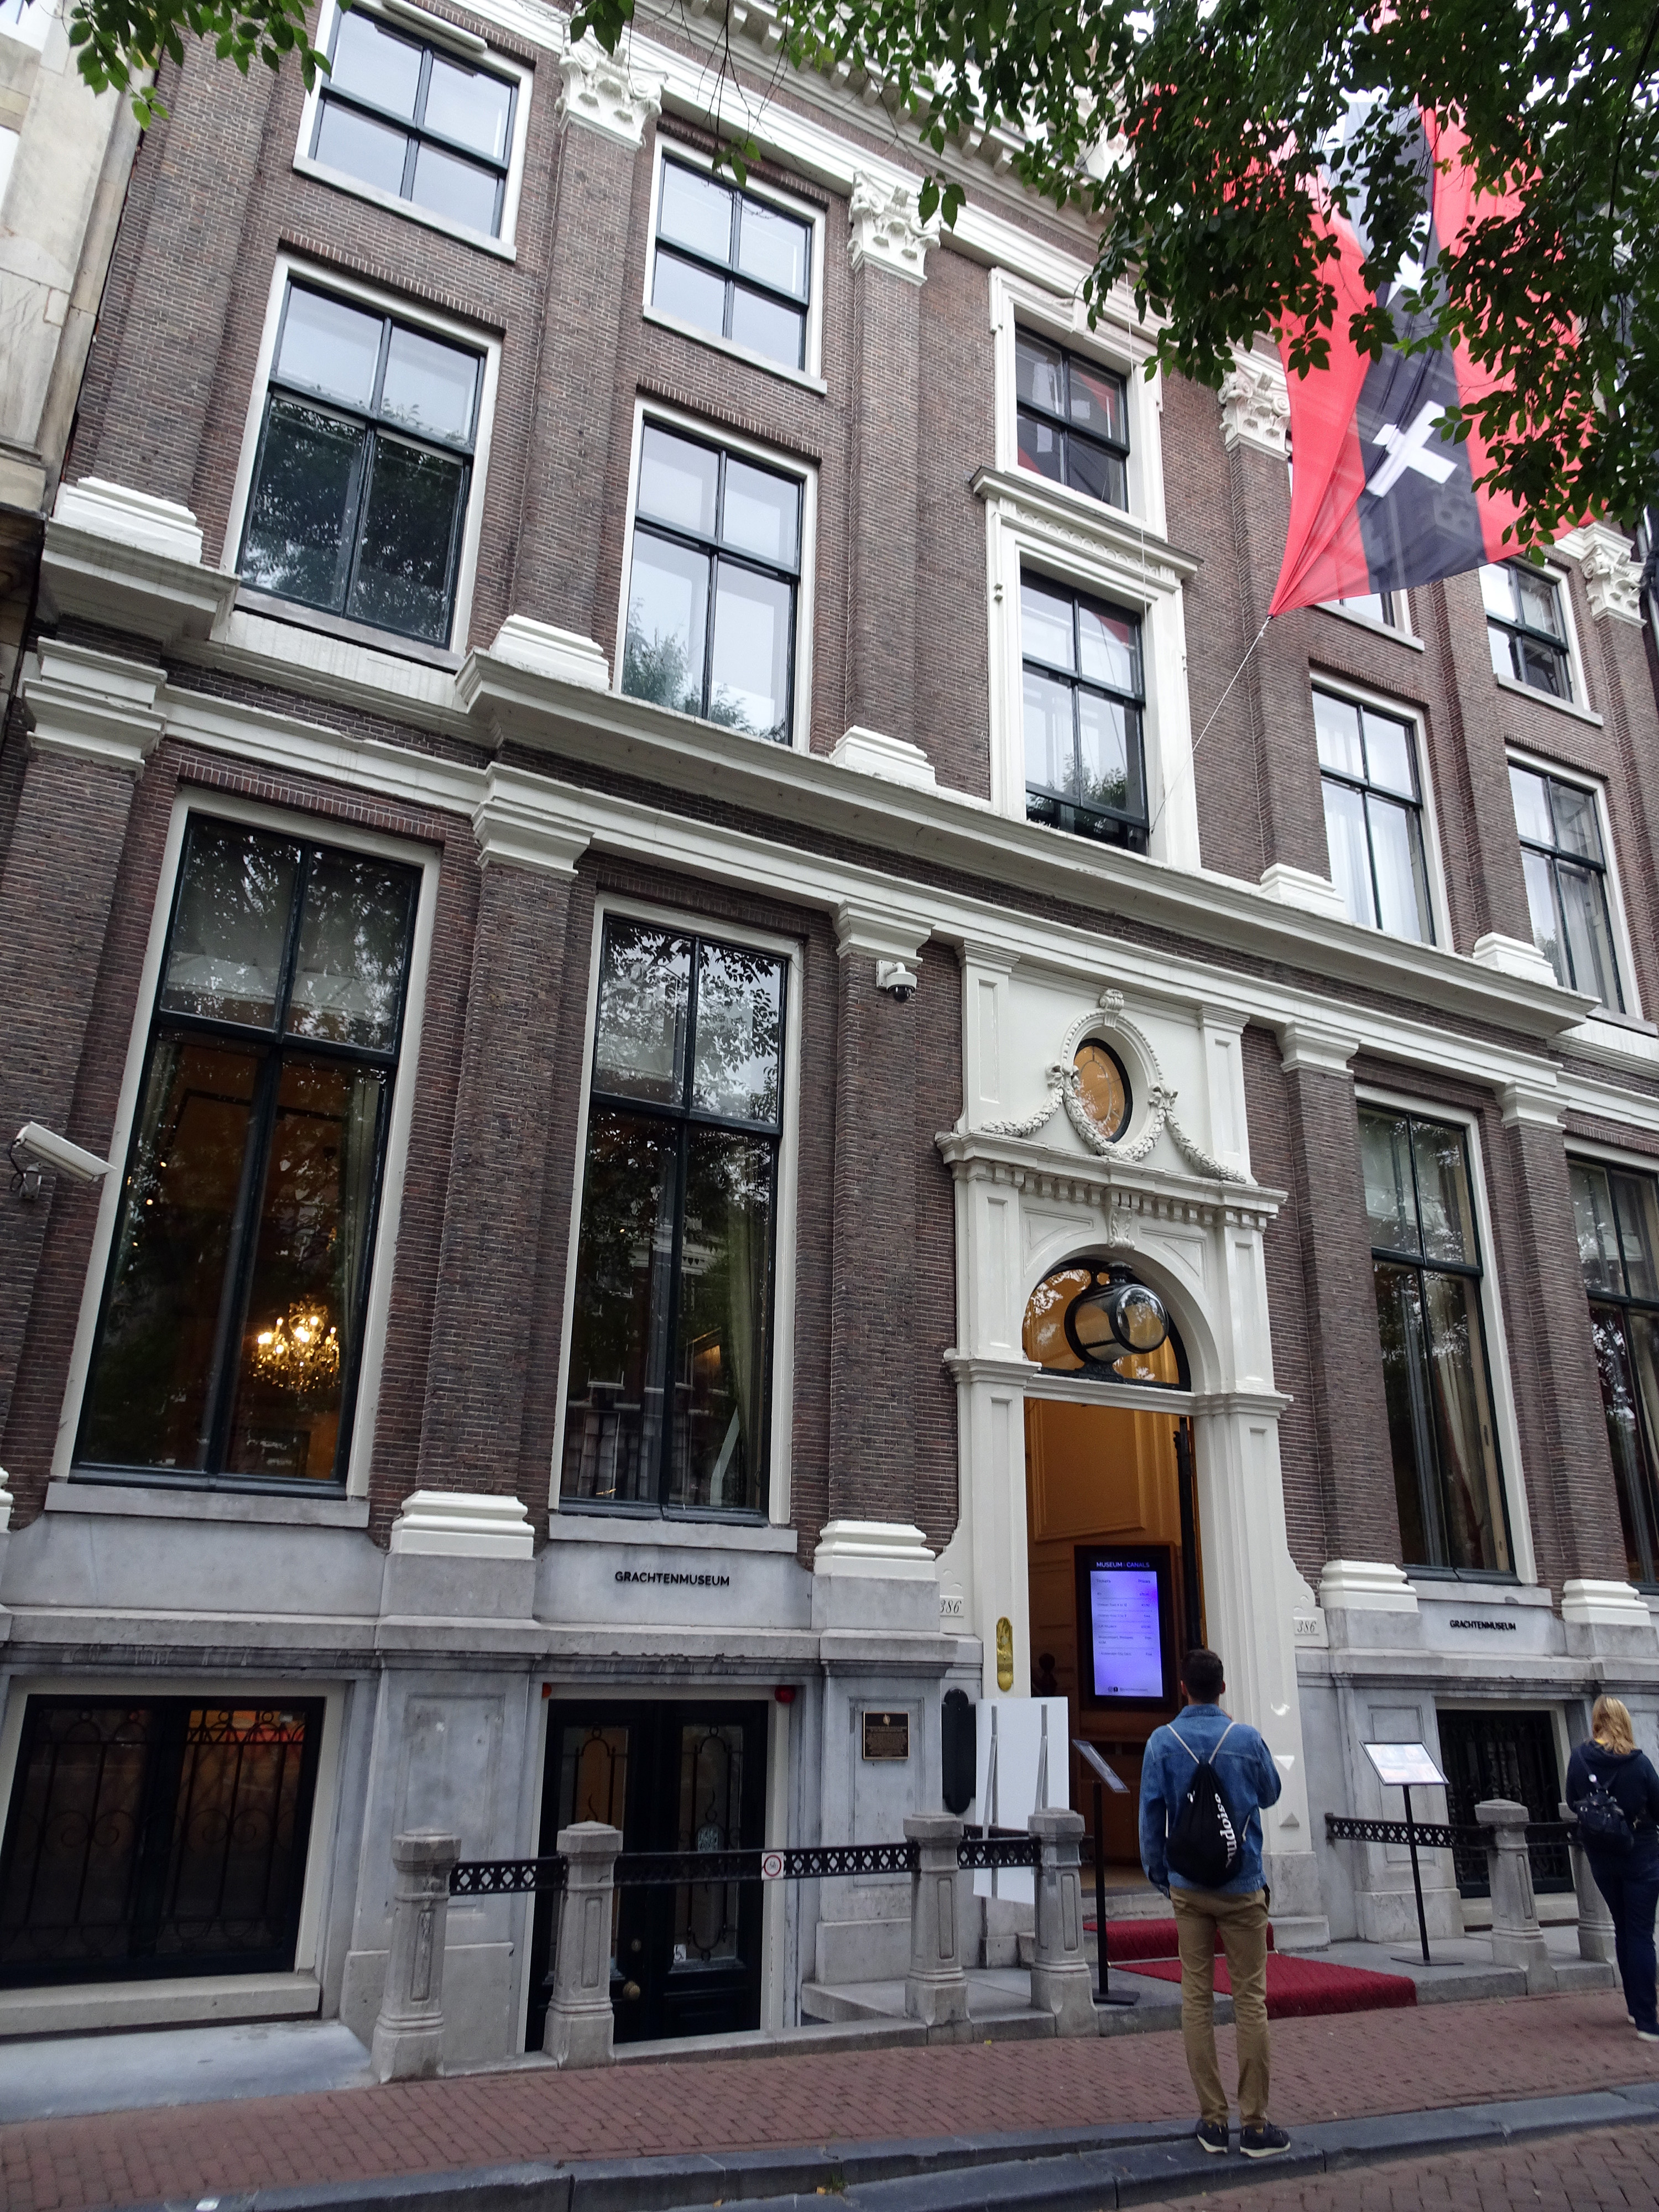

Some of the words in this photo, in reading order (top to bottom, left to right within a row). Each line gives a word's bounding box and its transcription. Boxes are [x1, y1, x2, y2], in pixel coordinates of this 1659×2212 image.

[615, 1571, 730, 1586] GRACHTENMUSEUM
[940, 1599, 962, 1614] 386
[1297, 1620, 1317, 1633] 386
[1449, 1620, 1516, 1630] GRACHTENMUSEUM
